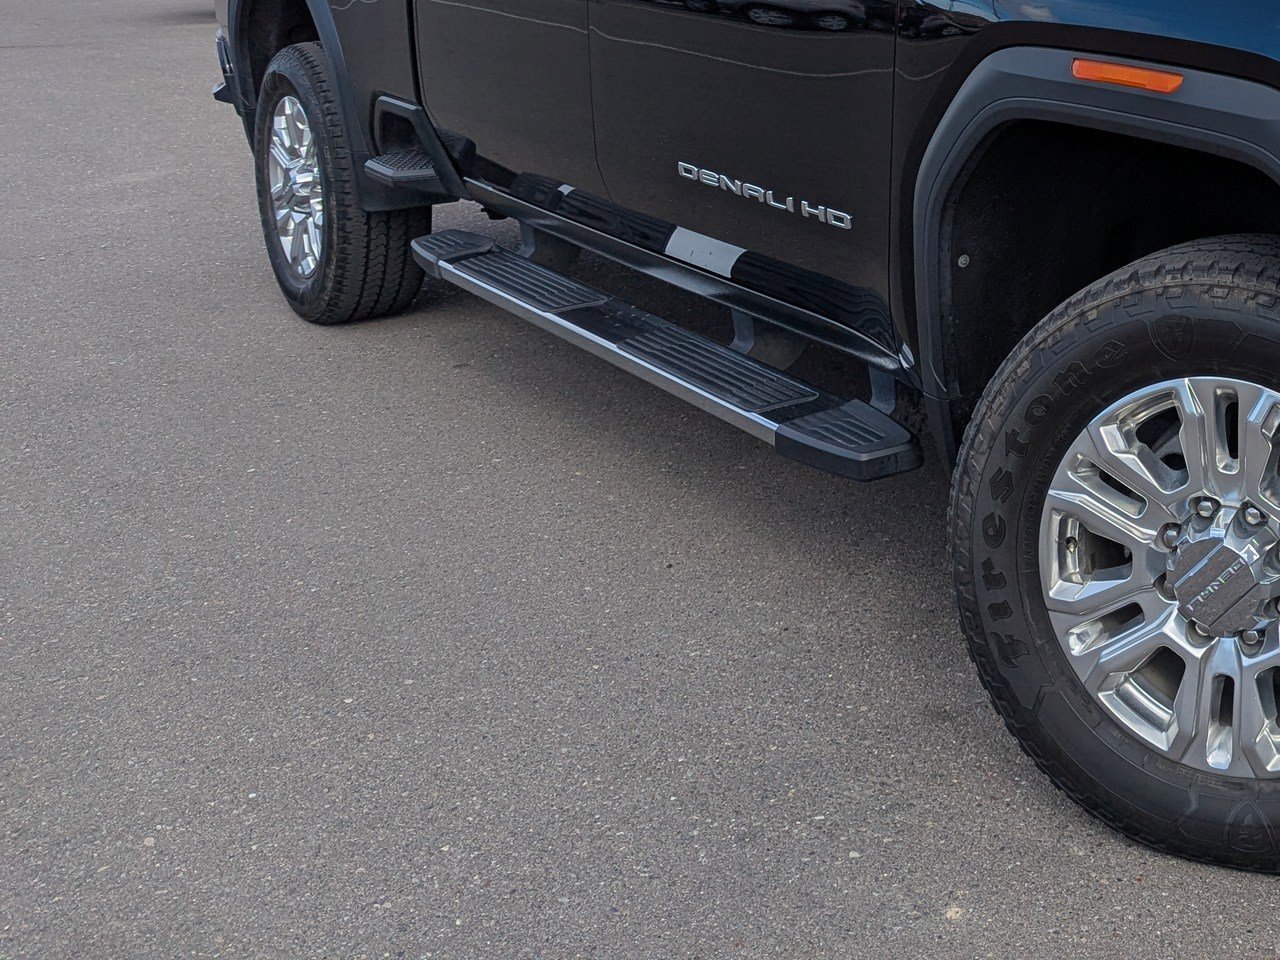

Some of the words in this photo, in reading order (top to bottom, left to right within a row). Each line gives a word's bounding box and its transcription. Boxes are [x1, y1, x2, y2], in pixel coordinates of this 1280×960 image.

[677, 160, 795, 213] DENALI
[801, 200, 853, 230] HD
[1185, 556, 1247, 613] DENALI
